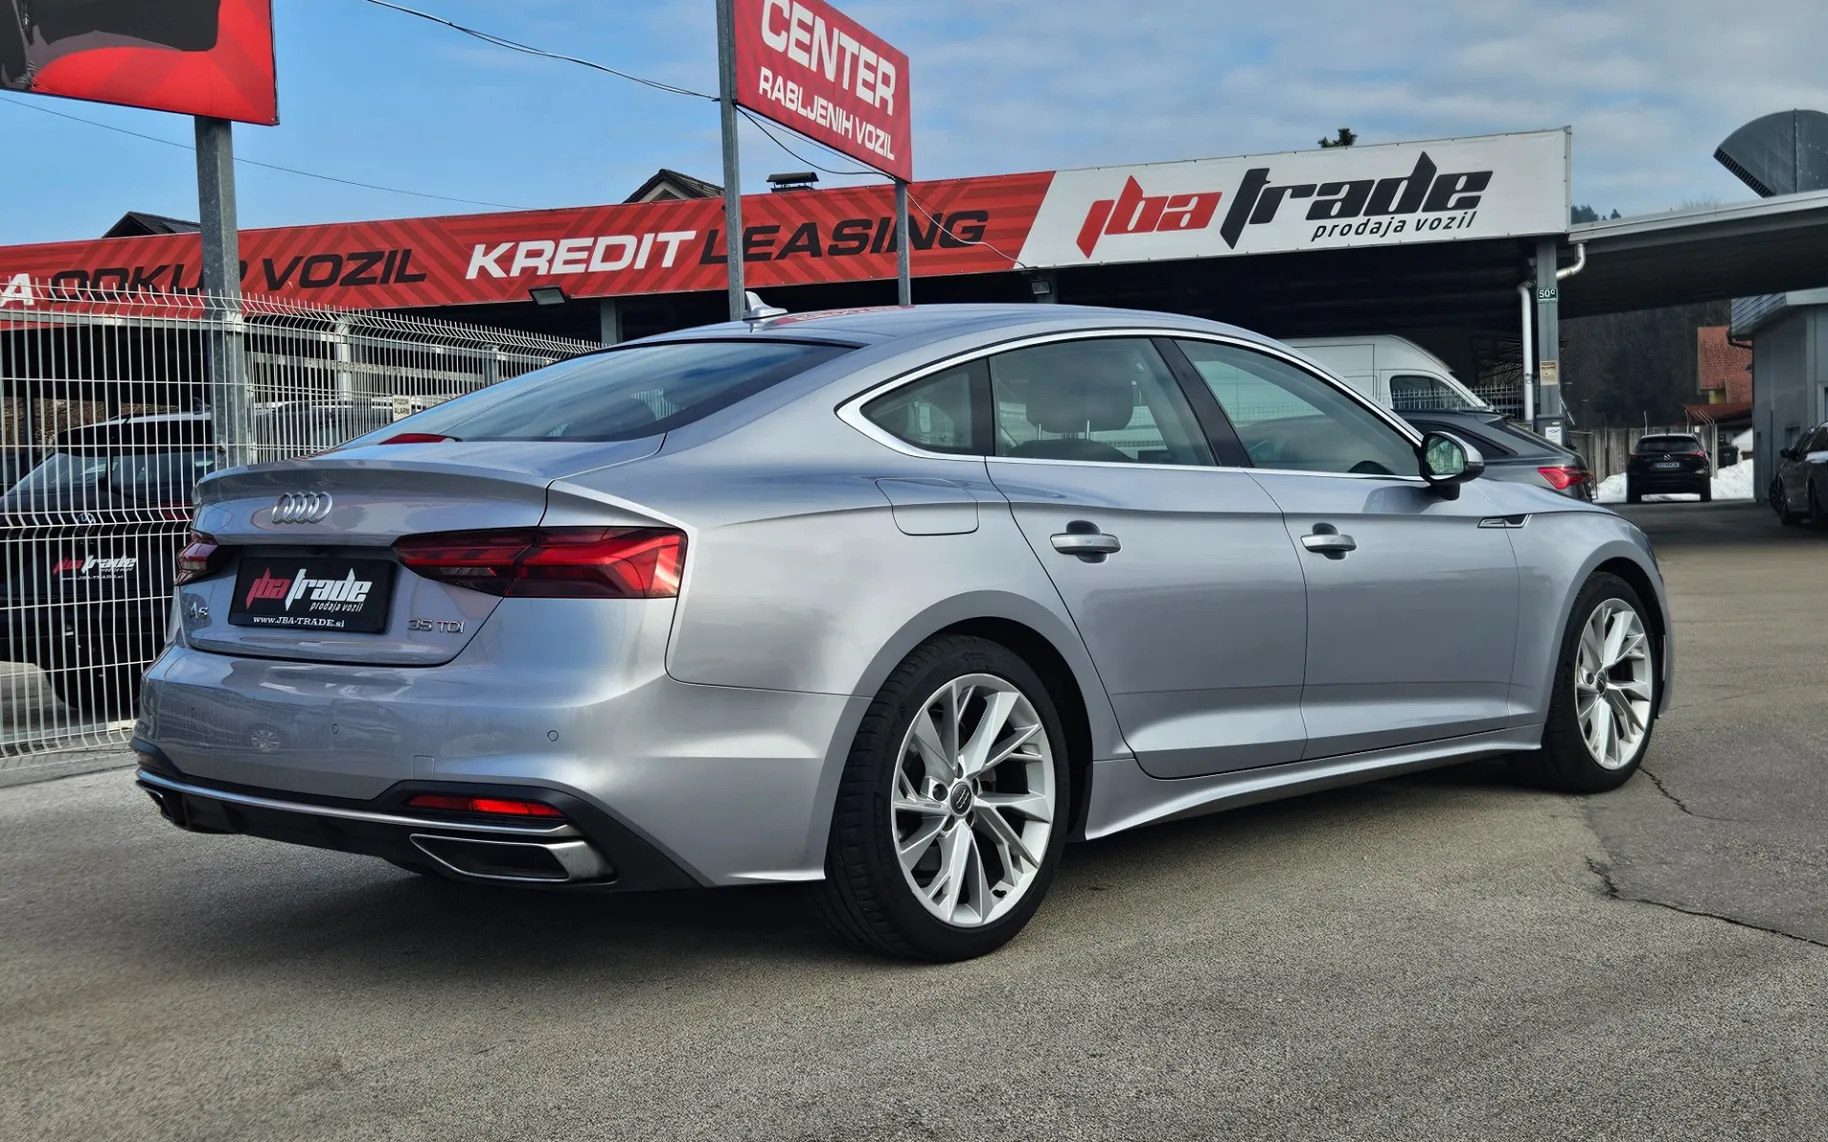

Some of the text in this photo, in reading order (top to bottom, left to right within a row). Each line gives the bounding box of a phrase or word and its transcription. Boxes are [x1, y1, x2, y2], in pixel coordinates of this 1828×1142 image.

[761, 0, 896, 116] CENTER
[759, 66, 895, 161] RABLJENIH VOZIL
[1220, 151, 1493, 250] trade
[1311, 211, 1477, 242] prodaja vozil
[50, 259, 248, 303] ODKU
[262, 248, 426, 291] VOZIL
[465, 230, 697, 280] KREDIT
[699, 210, 989, 266] LEASING
[285, 567, 373, 612] trade
[309, 601, 364, 613] prodaja vozil
[253, 616, 345, 628] www.JBA-TRADE.si
[408, 619, 465, 634] 35 TDI
